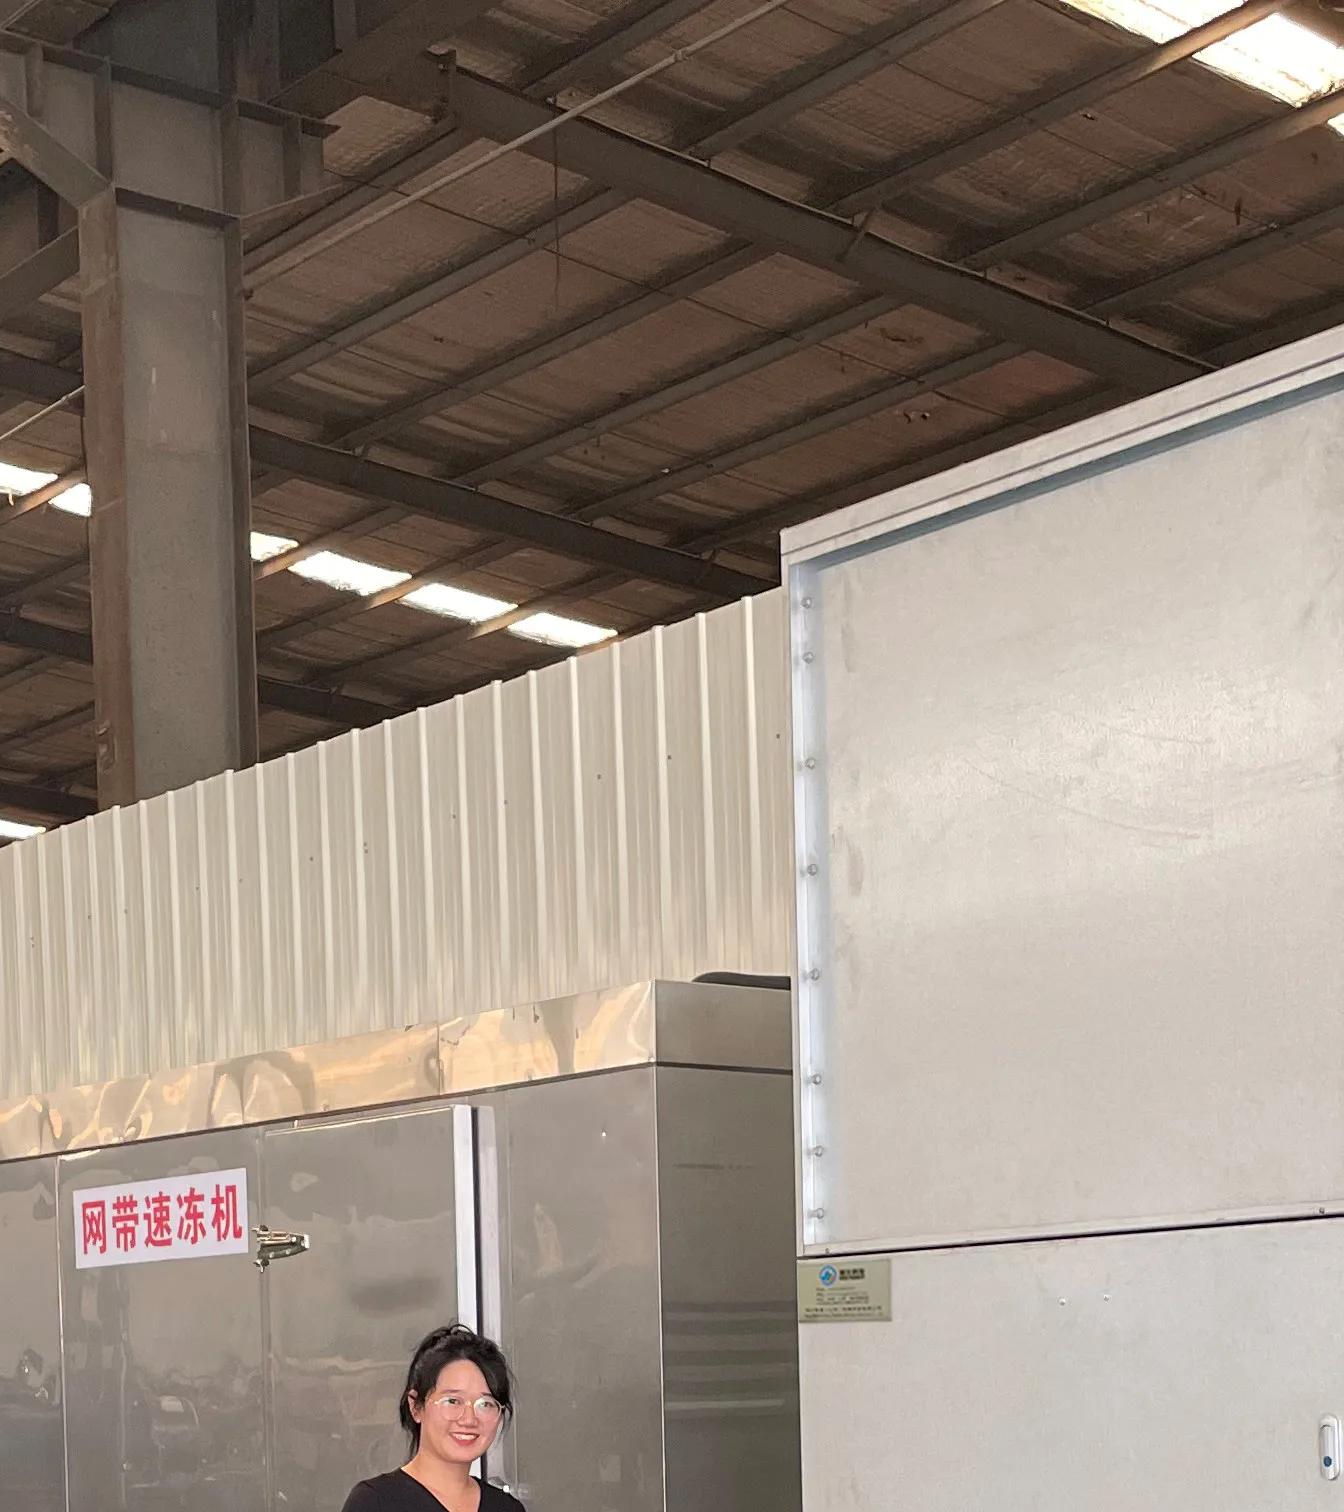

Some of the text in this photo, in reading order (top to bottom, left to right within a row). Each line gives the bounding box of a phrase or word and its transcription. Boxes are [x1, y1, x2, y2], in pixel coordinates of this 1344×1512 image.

[81, 1183, 243, 1255] 网带速冻机
